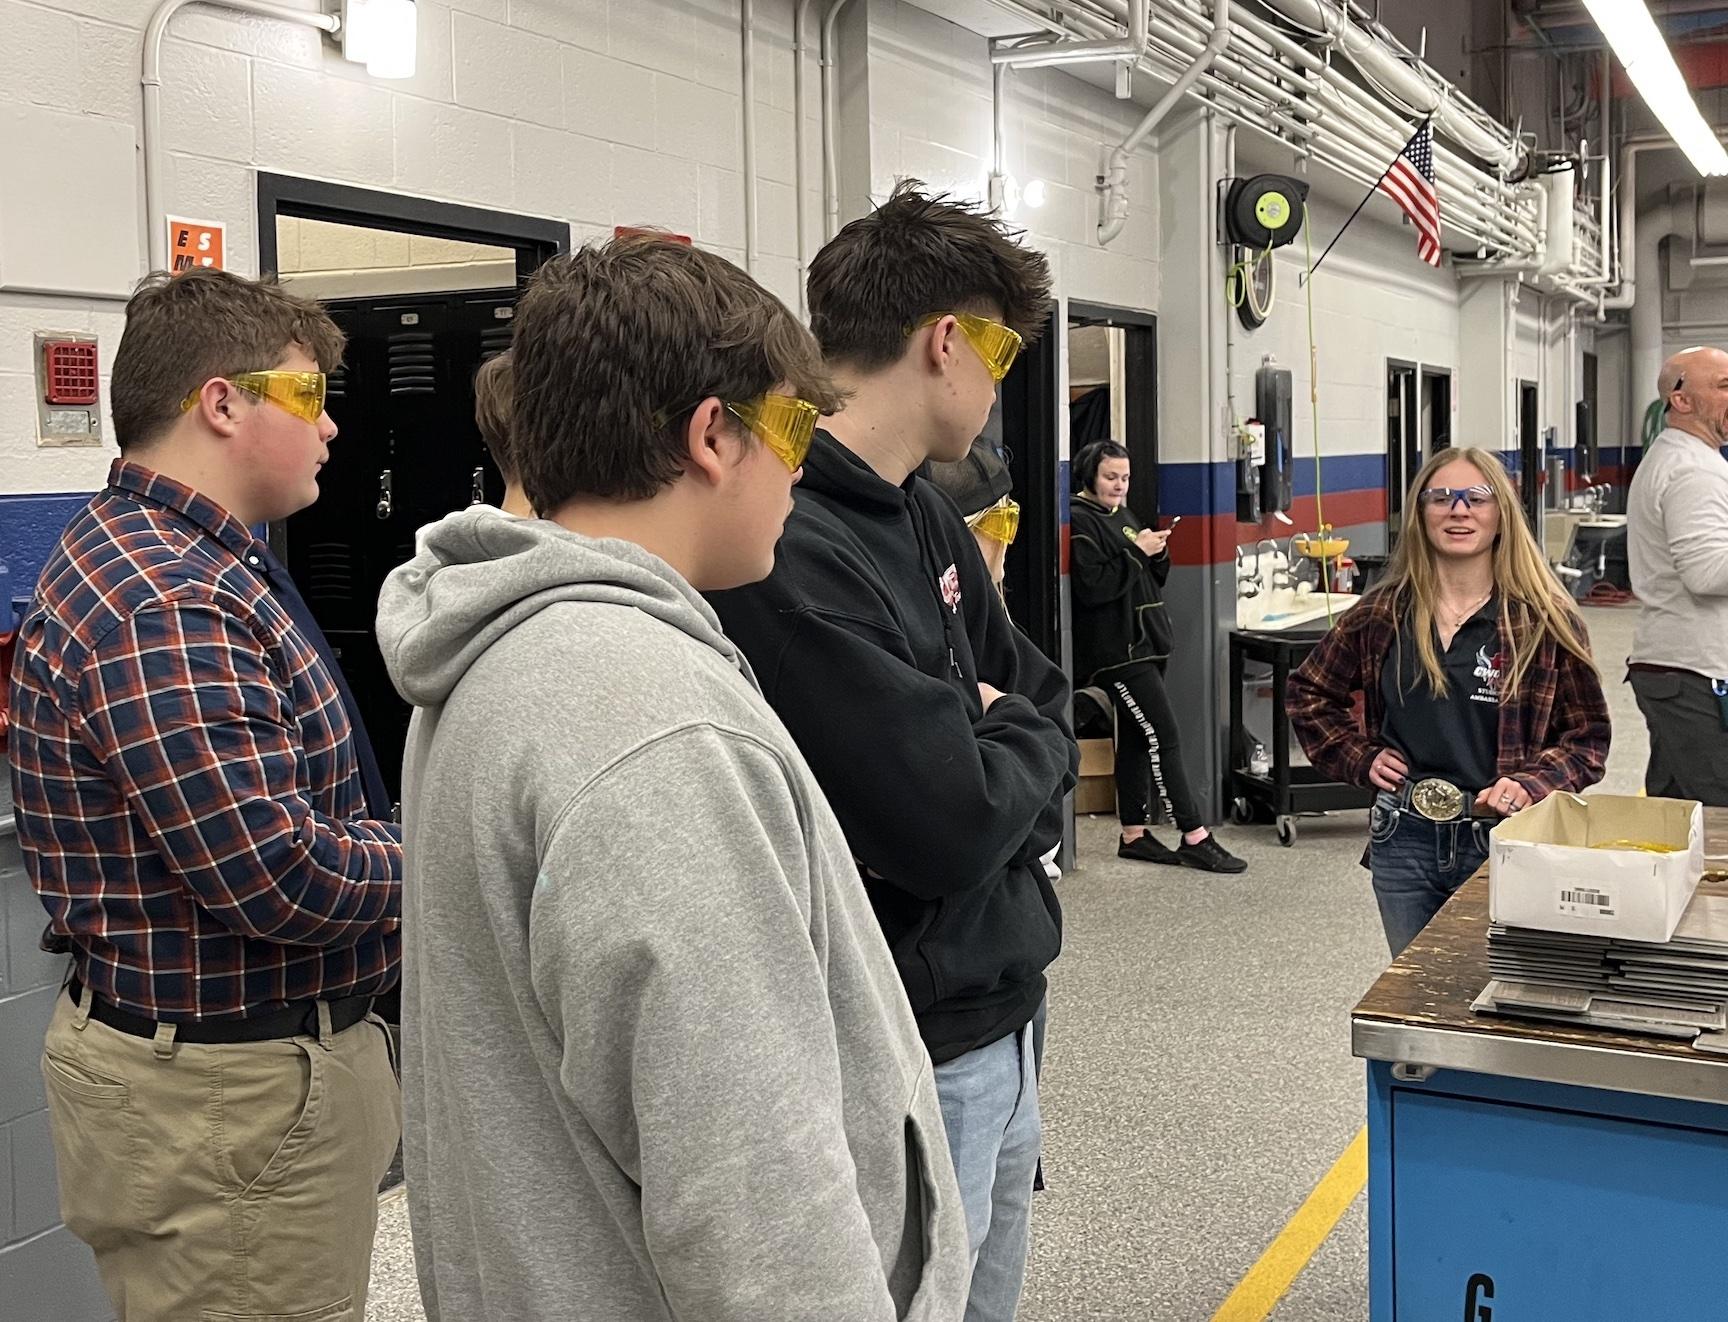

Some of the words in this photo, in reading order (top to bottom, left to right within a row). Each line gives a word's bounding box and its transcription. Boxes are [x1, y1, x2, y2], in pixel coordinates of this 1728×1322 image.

[178, 230, 188, 247] E
[198, 232, 211, 251] S
[1464, 1273, 1494, 1322] G
